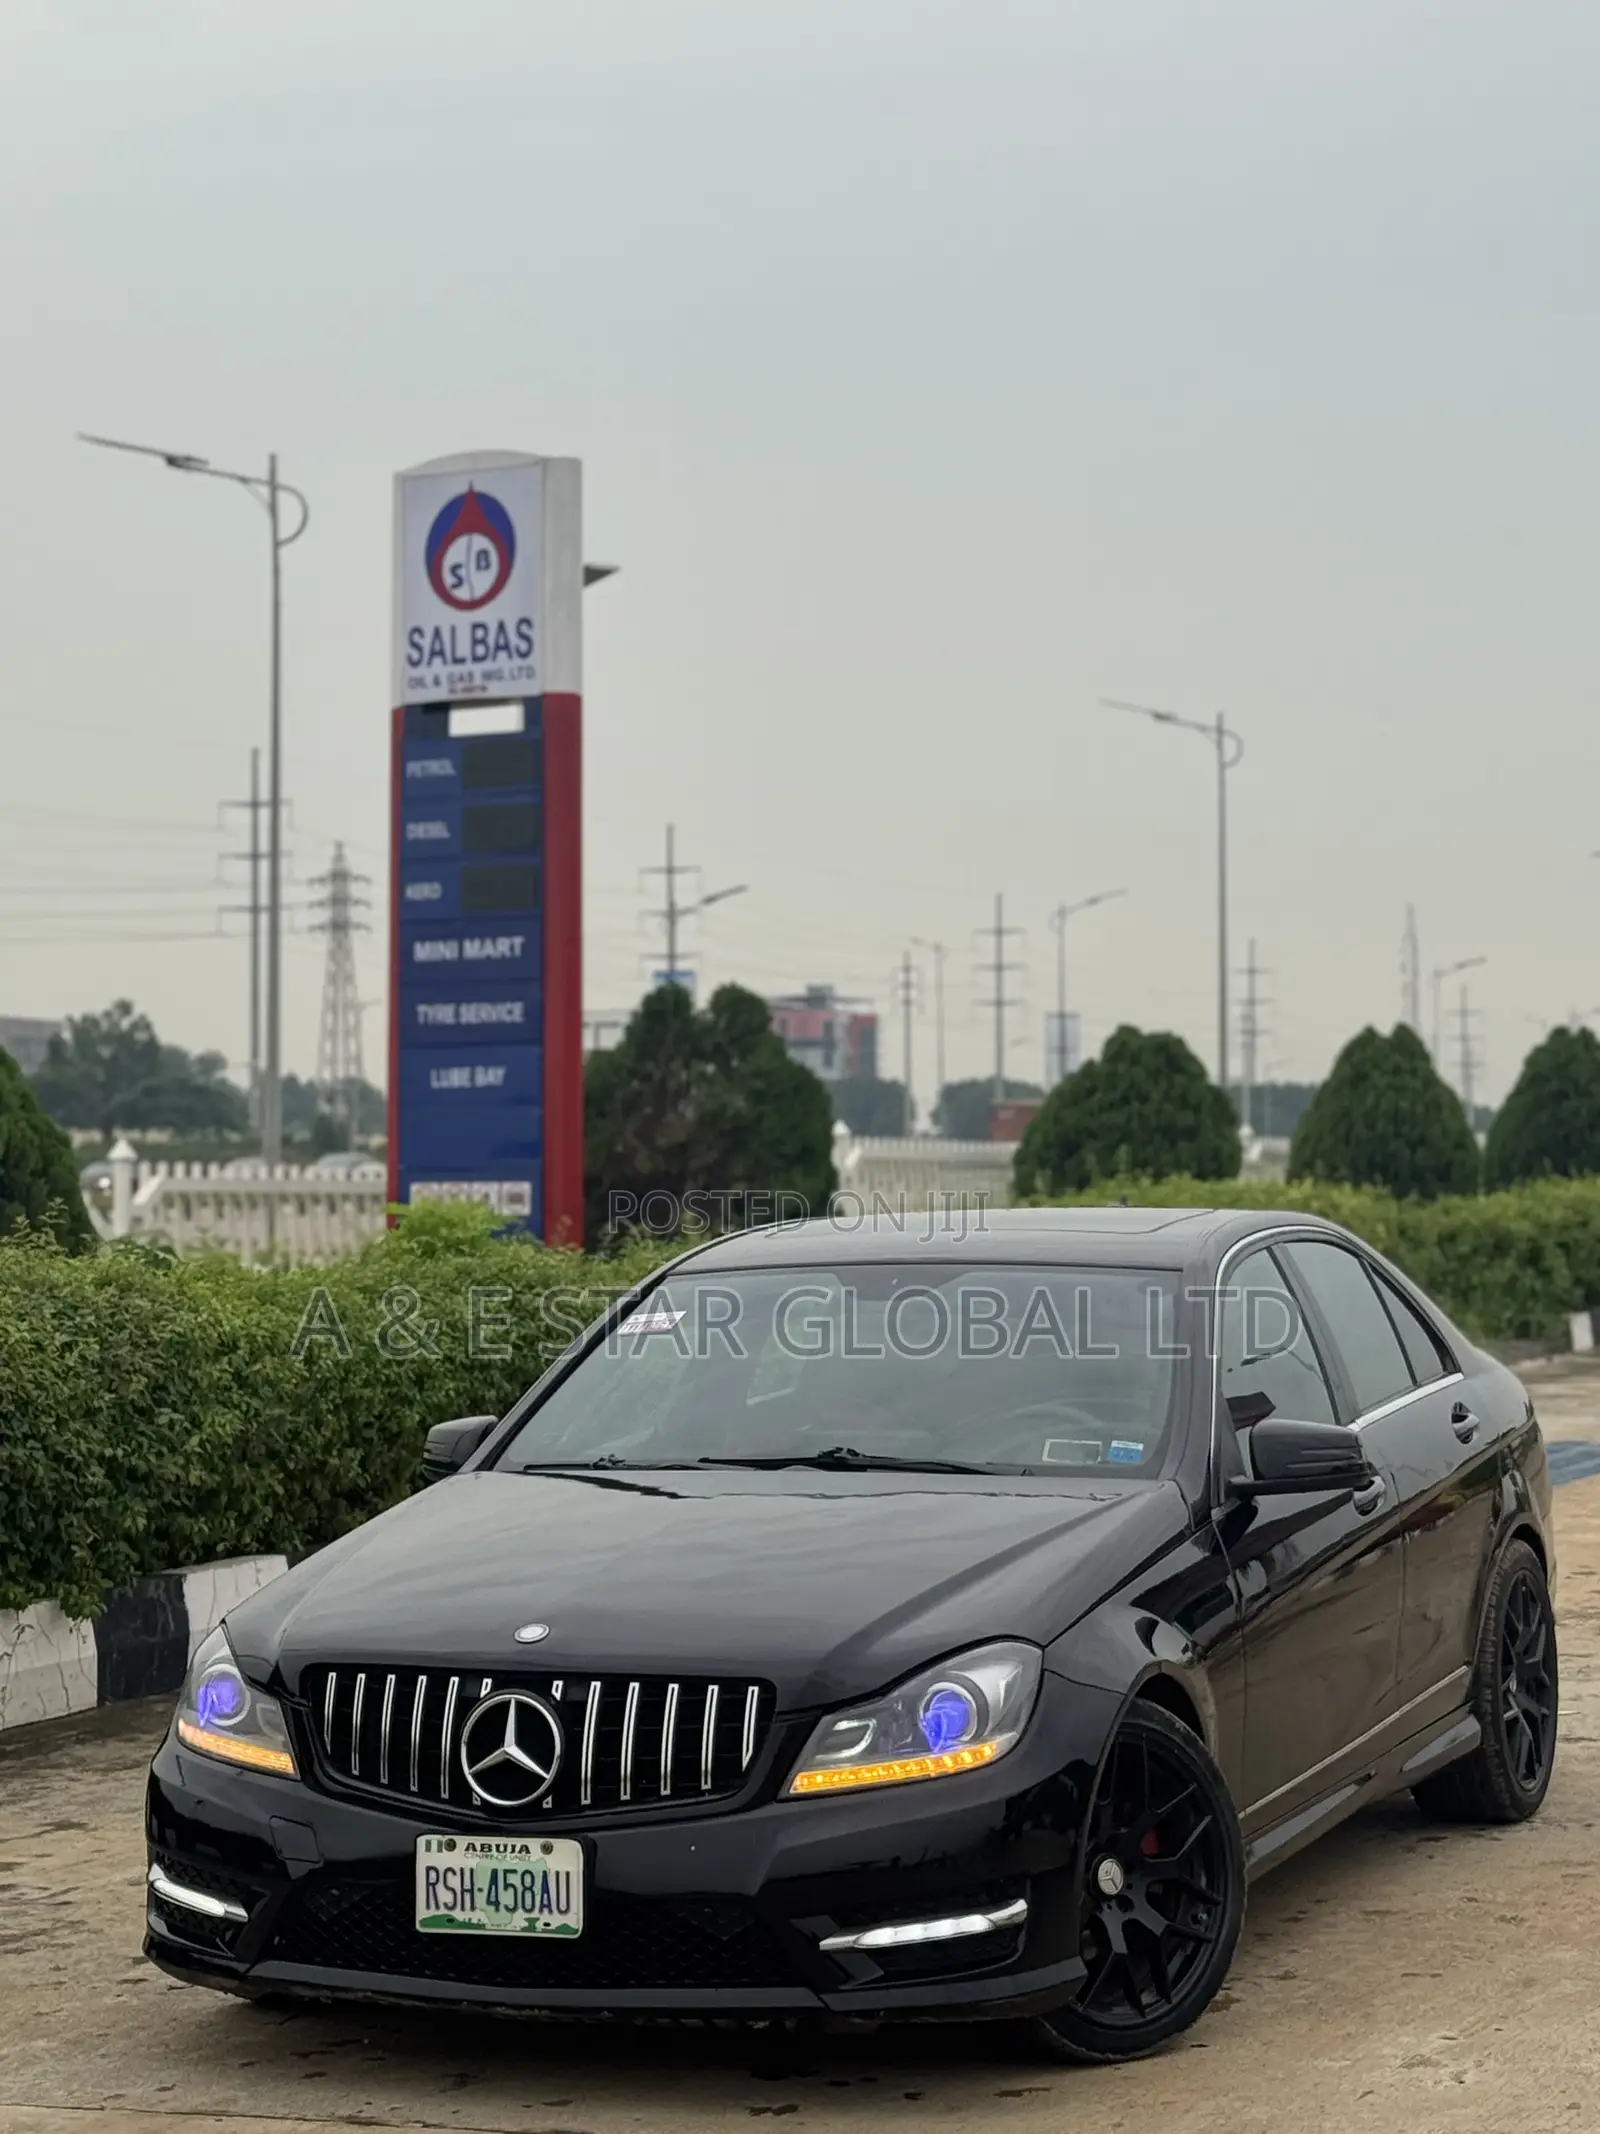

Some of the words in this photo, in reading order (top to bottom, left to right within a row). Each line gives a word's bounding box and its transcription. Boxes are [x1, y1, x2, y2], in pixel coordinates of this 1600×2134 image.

[450, 563, 464, 589] S
[406, 617, 533, 668] SALBAS
[413, 940, 459, 962] MINI
[463, 936, 525, 959] MART
[416, 1003, 455, 1024] TYRE
[459, 1001, 525, 1023] SERVICE
[430, 1068, 470, 1089] LUBE
[475, 1066, 505, 1087] BAY
[464, 1842, 531, 1855] ABUJA
[425, 1865, 570, 1915] RSH-458AU
